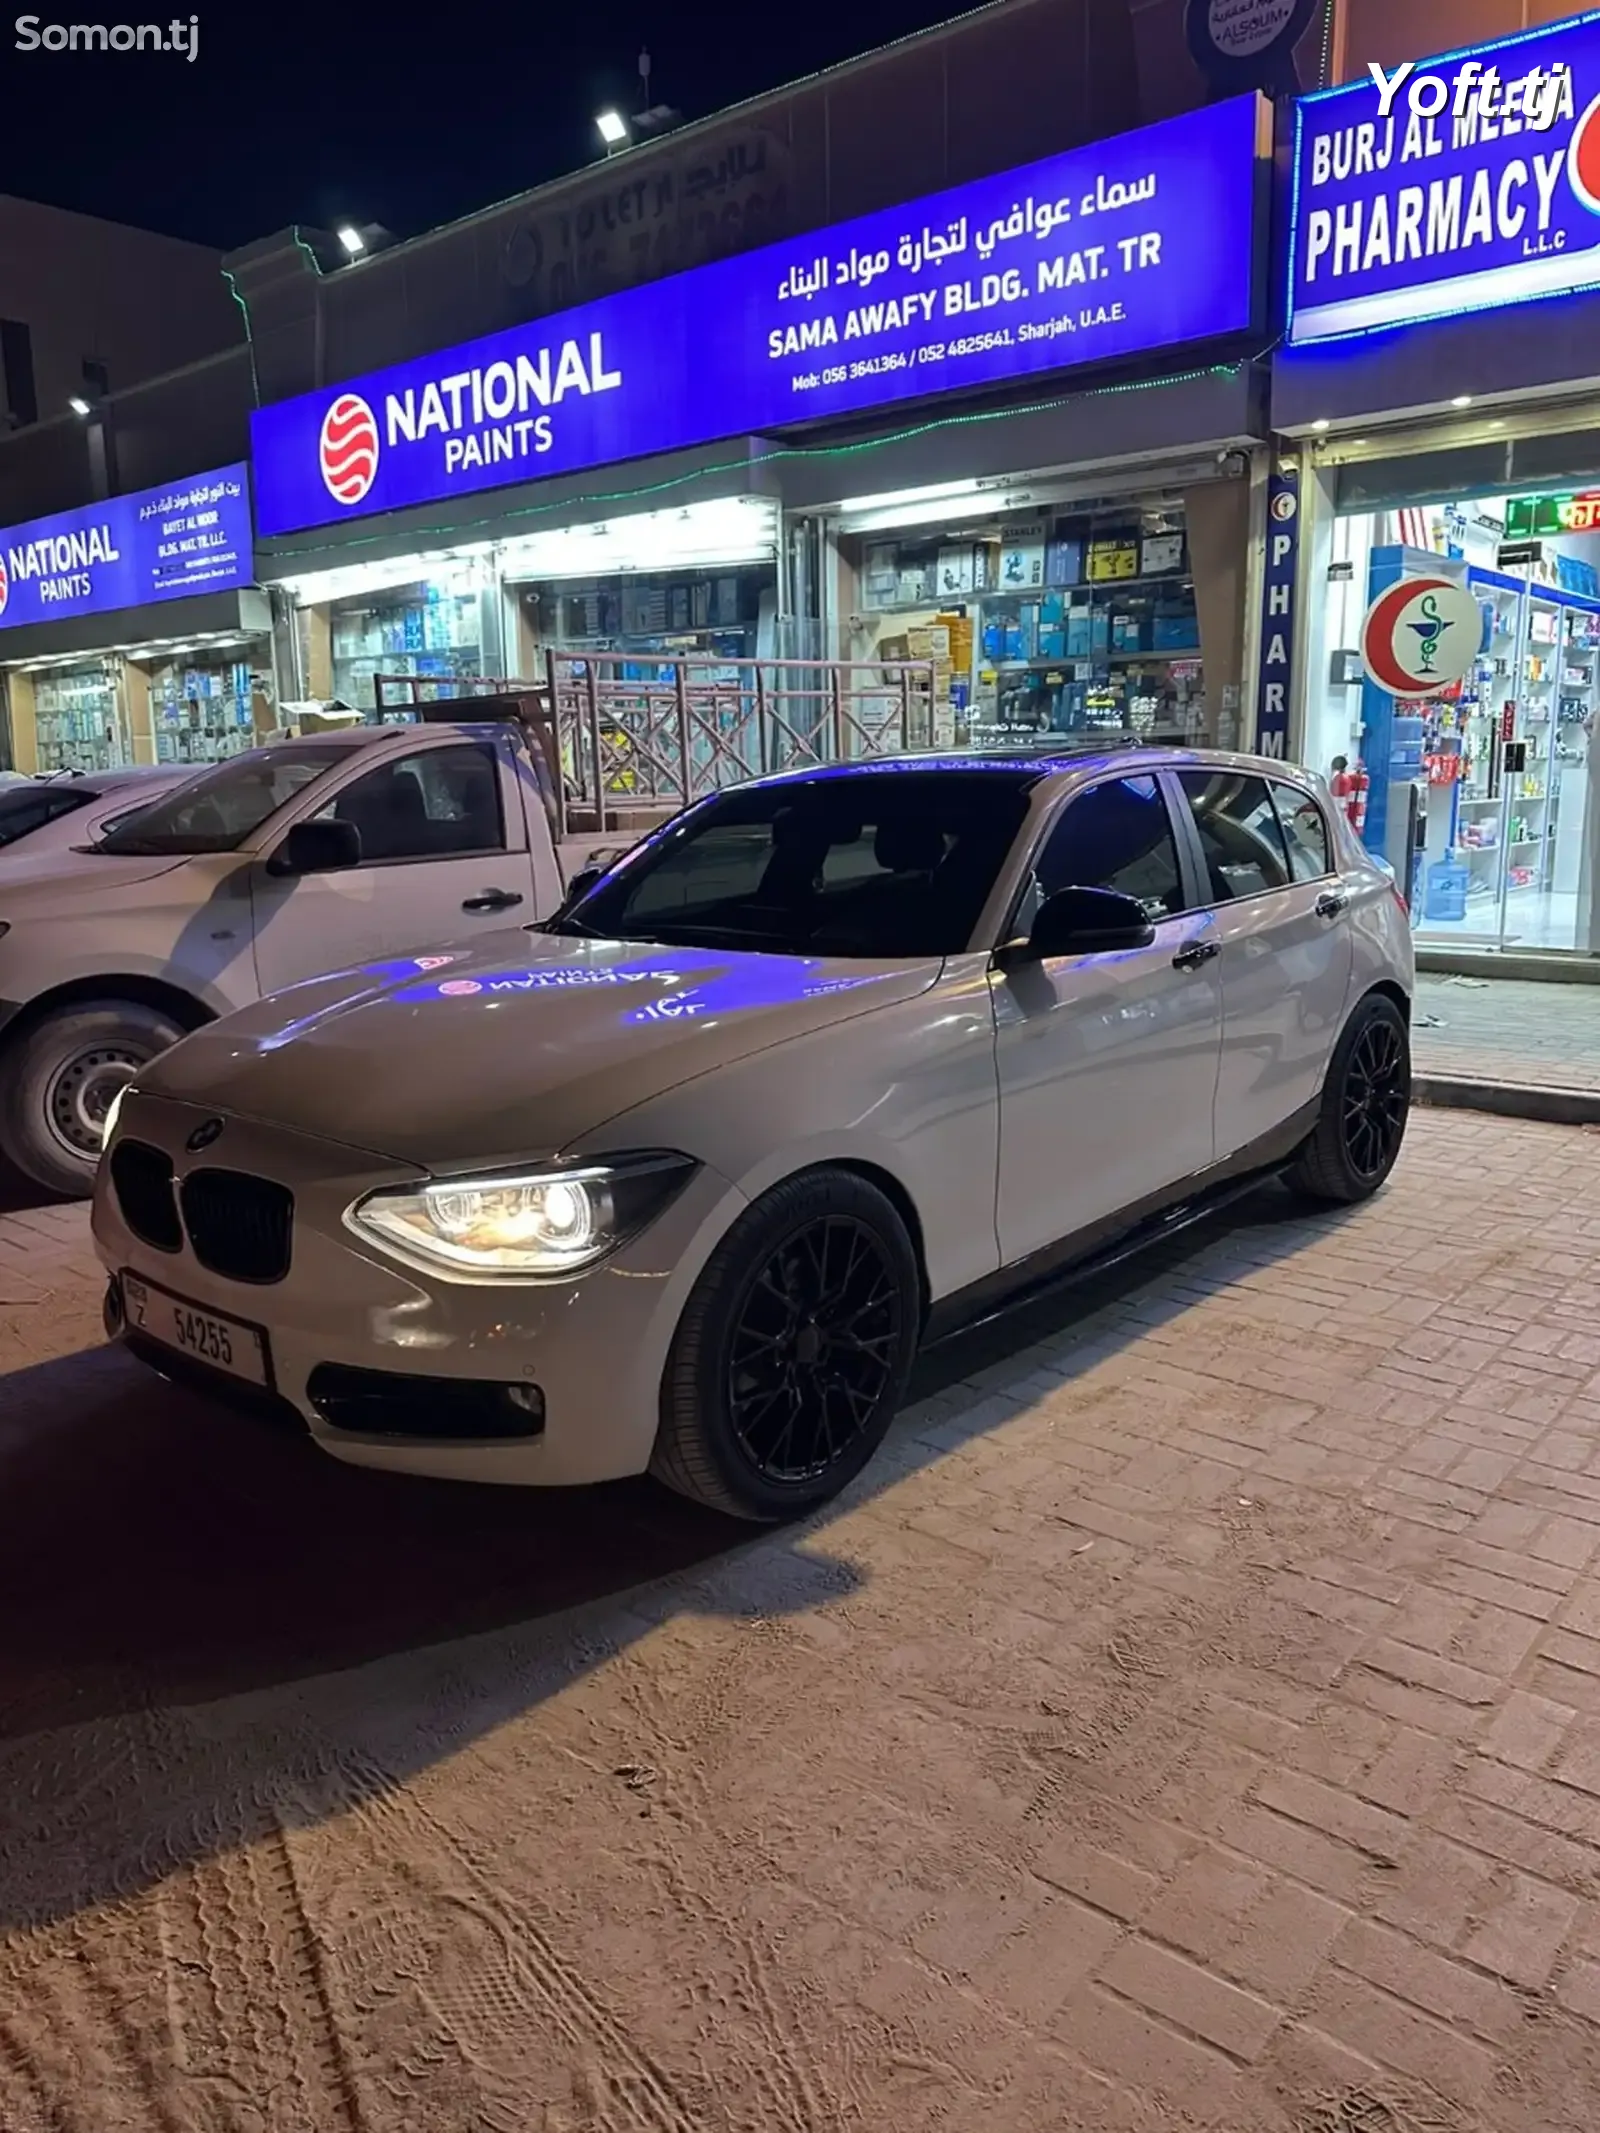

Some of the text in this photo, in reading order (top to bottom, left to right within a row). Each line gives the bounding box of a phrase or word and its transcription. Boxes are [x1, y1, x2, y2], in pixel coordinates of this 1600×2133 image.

[1312, 115, 1394, 186] BURJ
[1400, 110, 1443, 163] AL
[778, 173, 1156, 301] سماء عوافي لتجارة مواد البناء
[1306, 149, 1566, 283] PHARMACY
[1523, 230, 1566, 256] L.L.C
[768, 232, 1161, 358] SAMA AWAFY BLDG. MAT. TR
[792, 374, 820, 392] Mob:
[822, 365, 847, 385] 056
[849, 353, 907, 379] 3641364
[918, 343, 945, 363] 052
[1080, 302, 1126, 328] U.A.E.
[386, 331, 622, 447] NATIONAL
[445, 414, 553, 474] PAINTS
[8, 524, 120, 582] NATIONAL
[40, 572, 92, 603] PAINTS
[173, 1306, 233, 1365] 54255
